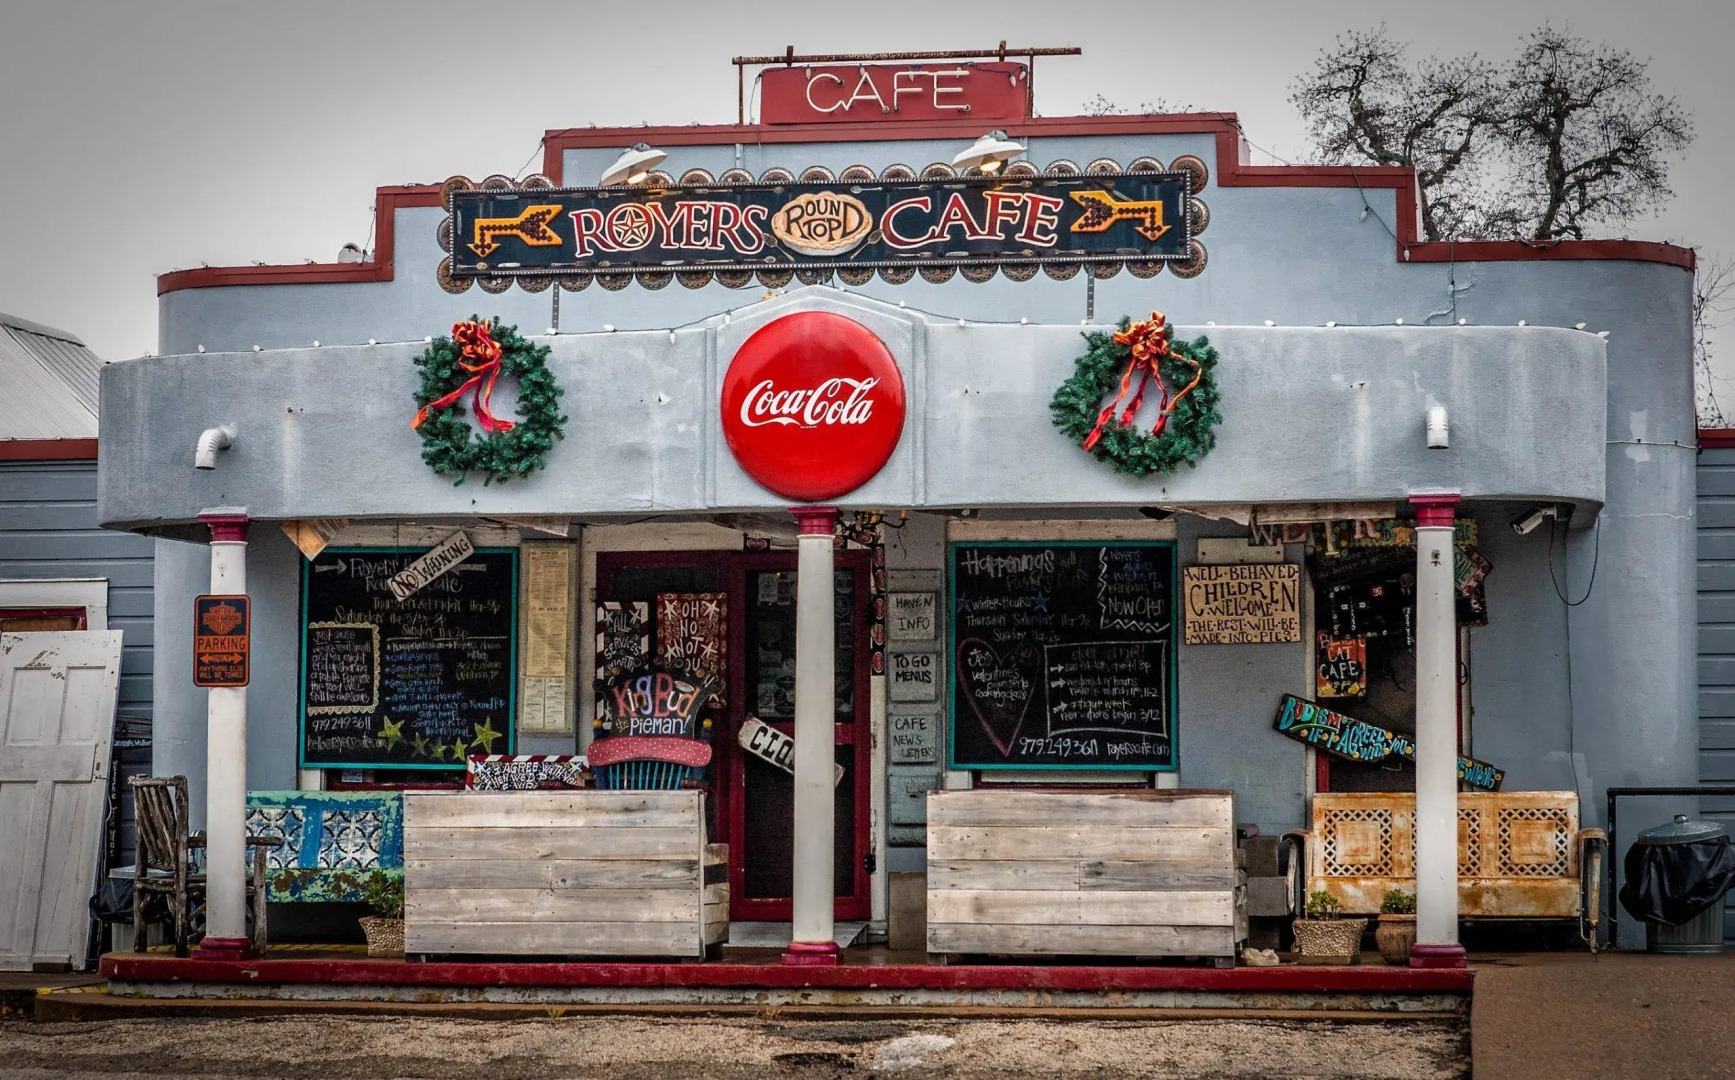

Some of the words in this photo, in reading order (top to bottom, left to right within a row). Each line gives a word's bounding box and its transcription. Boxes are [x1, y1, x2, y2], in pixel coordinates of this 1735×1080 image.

[806, 70, 971, 113] CAFE
[568, 201, 769, 258] ROYERS
[880, 191, 1064, 249] CAFE
[785, 199, 864, 240] ROUND
[803, 218, 842, 241] TOP
[740, 377, 881, 427] Coca-Cola
[413, 539, 470, 582] WHINING
[961, 549, 1055, 578] Happenings
[1186, 566, 1222, 581] WELL
[1229, 565, 1296, 580] BEHAVED
[896, 595, 933, 609] HAVEN
[1190, 579, 1297, 617] CHILDREN
[1208, 596, 1274, 617] WELCOME
[682, 600, 699, 618] OH
[680, 619, 698, 637] NO
[898, 616, 930, 631] INFO
[1190, 620, 1214, 632] THE
[1217, 618, 1246, 632] REST
[1247, 618, 1278, 631] WILL
[1281, 618, 1296, 630] BE
[198, 638, 246, 650] PARKING
[1190, 633, 1221, 643] MADE
[1229, 632, 1253, 642] INTO
[1260, 630, 1293, 642] PIES
[673, 636, 704, 658] NOT
[1328, 646, 1353, 662] CAT
[894, 653, 910, 668] TO
[912, 655, 931, 668] GO
[896, 670, 931, 683] MENUS
[1320, 661, 1358, 680] CAFE
[611, 676, 652, 717] King
[654, 672, 702, 717] Bud
[895, 718, 928, 731] CAFE
[1308, 727, 1323, 743] IF
[1327, 732, 1335, 748] I
[1335, 722, 1387, 755] AGREED
[503, 762, 539, 774] AGREE
